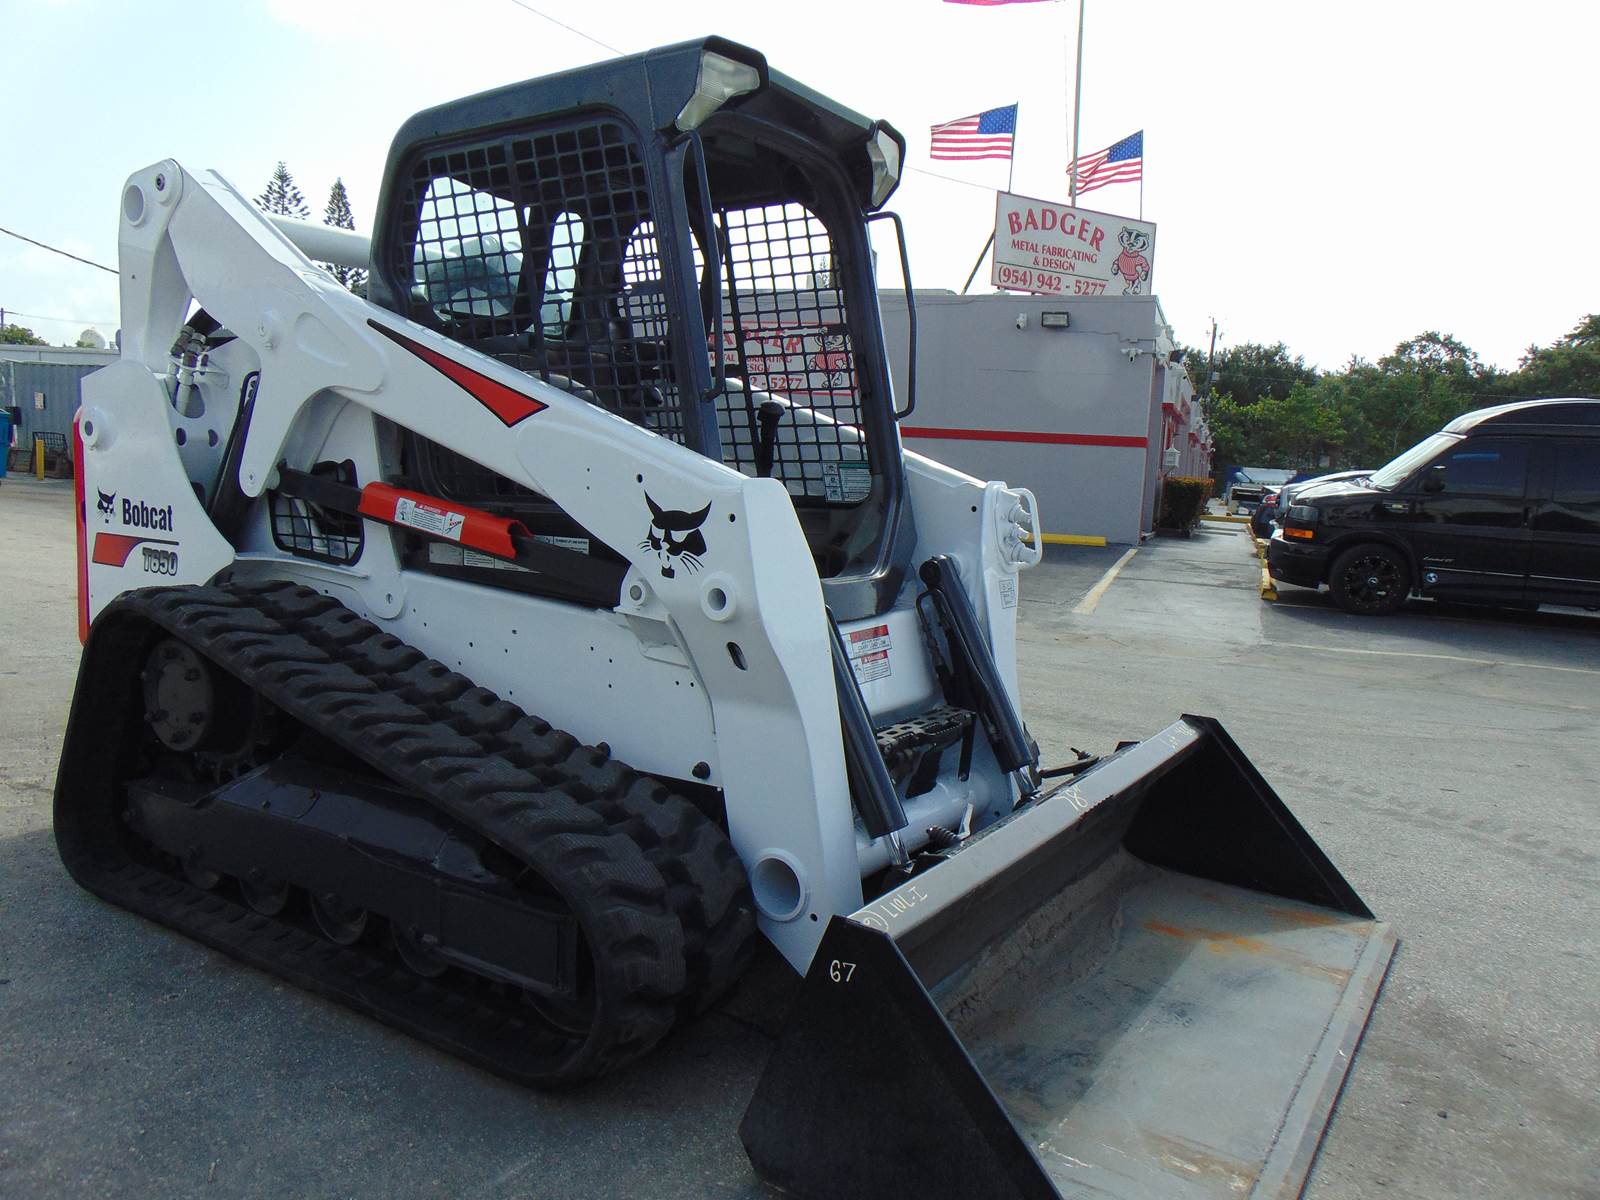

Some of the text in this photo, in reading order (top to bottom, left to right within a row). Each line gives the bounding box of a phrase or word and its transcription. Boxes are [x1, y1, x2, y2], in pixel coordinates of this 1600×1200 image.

[1008, 208, 1105, 252] BADGER
[1011, 239, 1098, 264] METAL FABRICATING
[1033, 257, 1076, 272] & DESIGN
[998, 265, 1033, 286] (954)
[1037, 275, 1062, 291] 942
[1074, 279, 1107, 296] 5277
[770, 376, 803, 390] 5277
[122, 498, 173, 532] Bobcat
[142, 547, 178, 576] T650
[830, 959, 857, 983] 67
